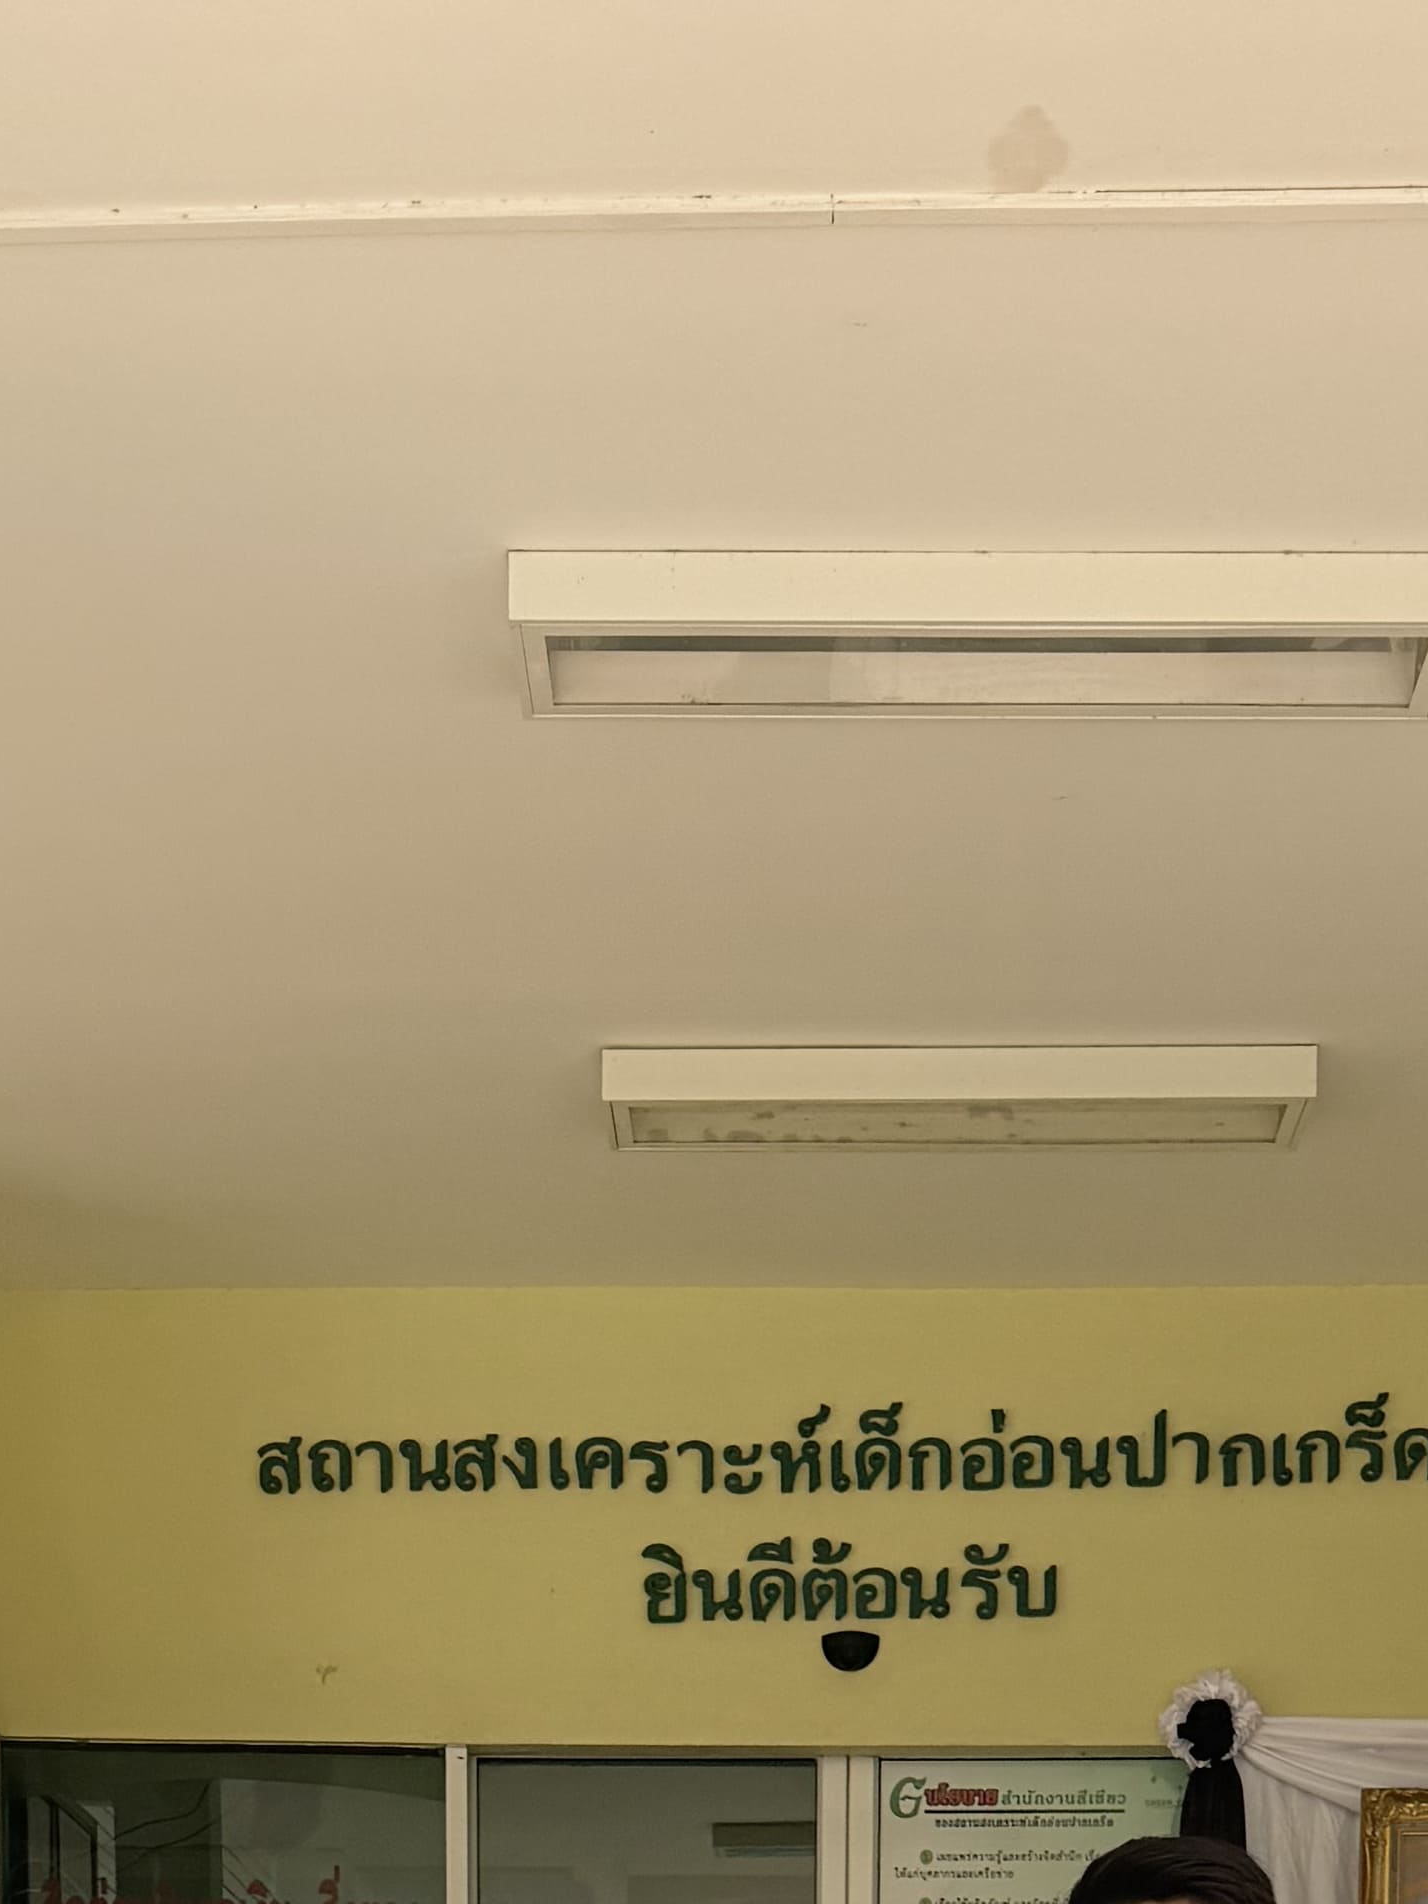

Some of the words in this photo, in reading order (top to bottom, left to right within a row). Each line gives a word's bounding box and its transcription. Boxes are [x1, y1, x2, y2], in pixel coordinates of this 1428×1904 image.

[640, 1536, 1057, 1623] ยินดีต้อนรับ
